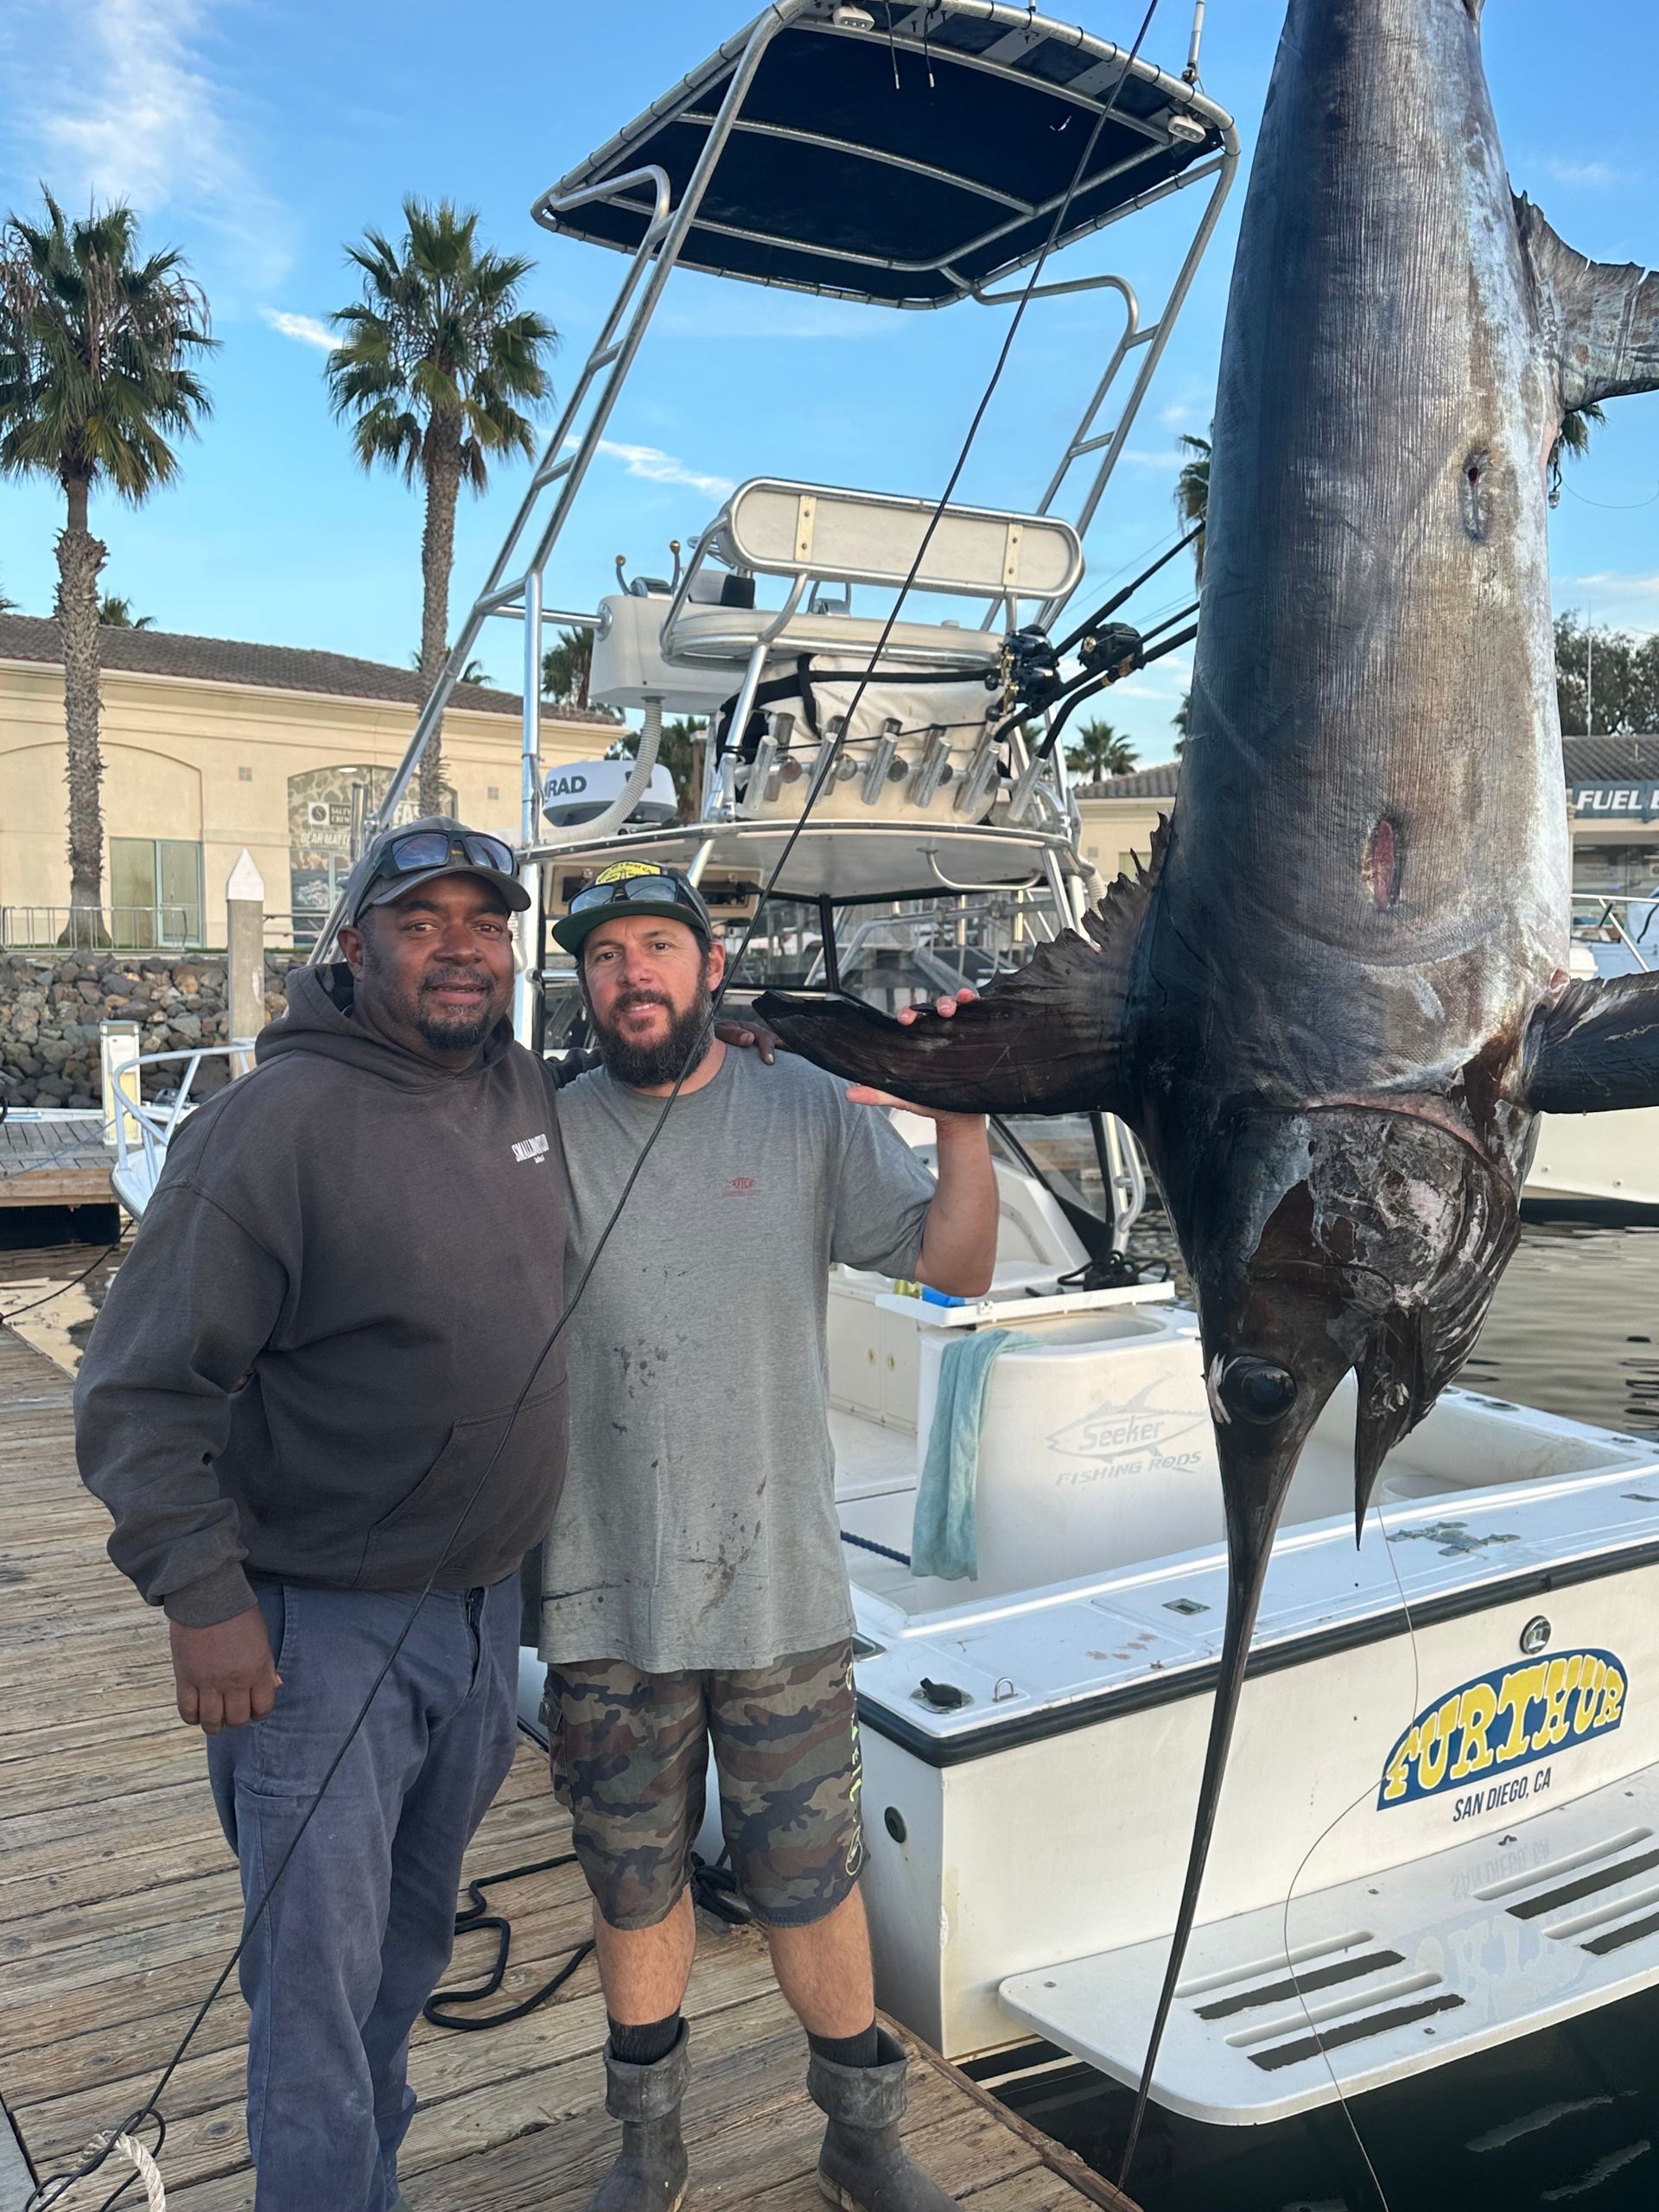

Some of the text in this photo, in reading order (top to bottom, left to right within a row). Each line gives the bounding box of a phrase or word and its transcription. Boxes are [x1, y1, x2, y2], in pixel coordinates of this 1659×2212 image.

[1577, 790, 1642, 810] FUEL
[1078, 1414, 1166, 1452] Seeker
[1055, 1451, 1202, 1486] FISHING RODS
[1382, 1654, 1623, 1801] FURTHUR
[1452, 1766, 1552, 1822] SAN DIEGO, CA
